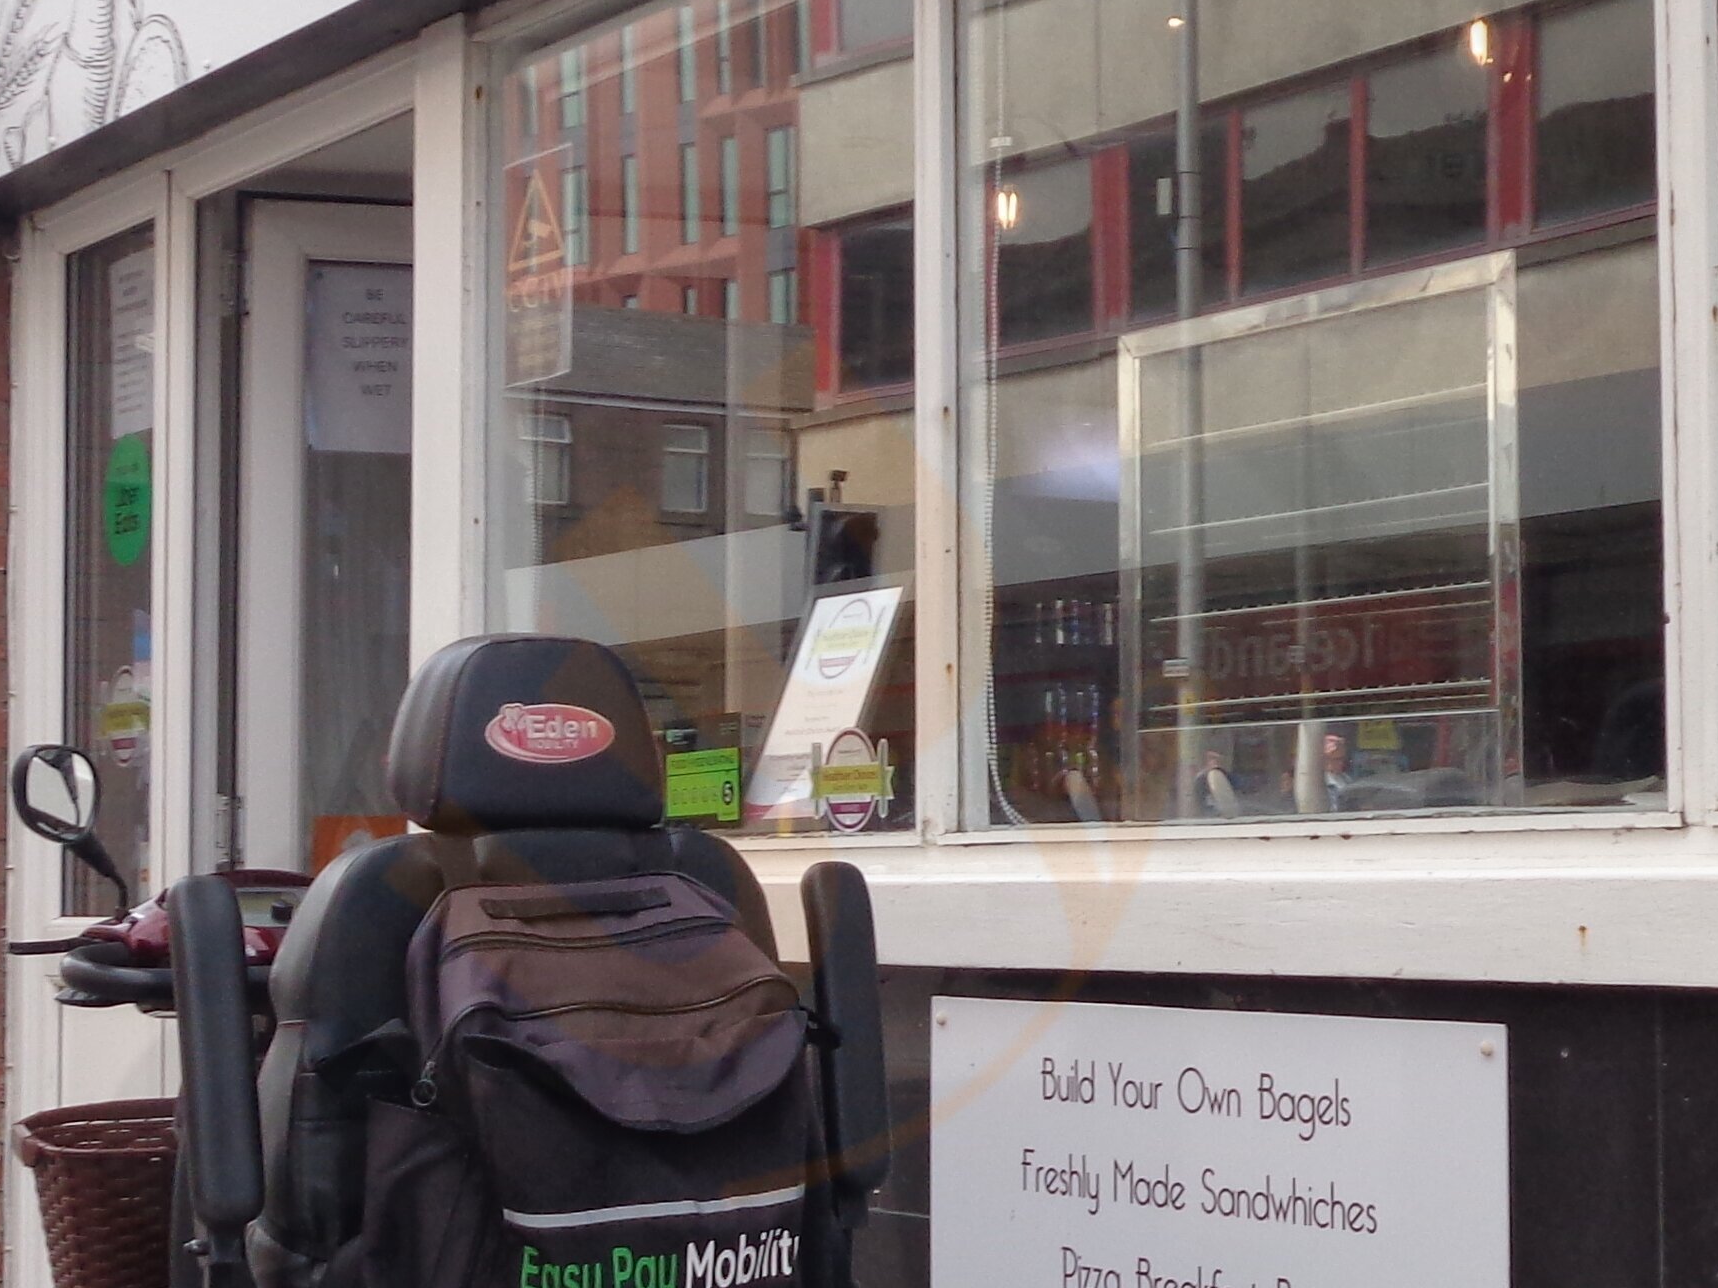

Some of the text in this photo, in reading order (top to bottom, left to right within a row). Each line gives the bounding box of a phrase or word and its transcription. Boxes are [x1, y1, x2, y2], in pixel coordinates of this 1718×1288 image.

[342, 336, 409, 349] SLIPPERY
[354, 360, 397, 372] WHEN
[361, 384, 391, 396] WET
[527, 715, 598, 739] Eden
[1041, 1057, 1352, 1140] Build Your Own Bagels
[1021, 1149, 1378, 1234] Freshly Made Sandwhiches
